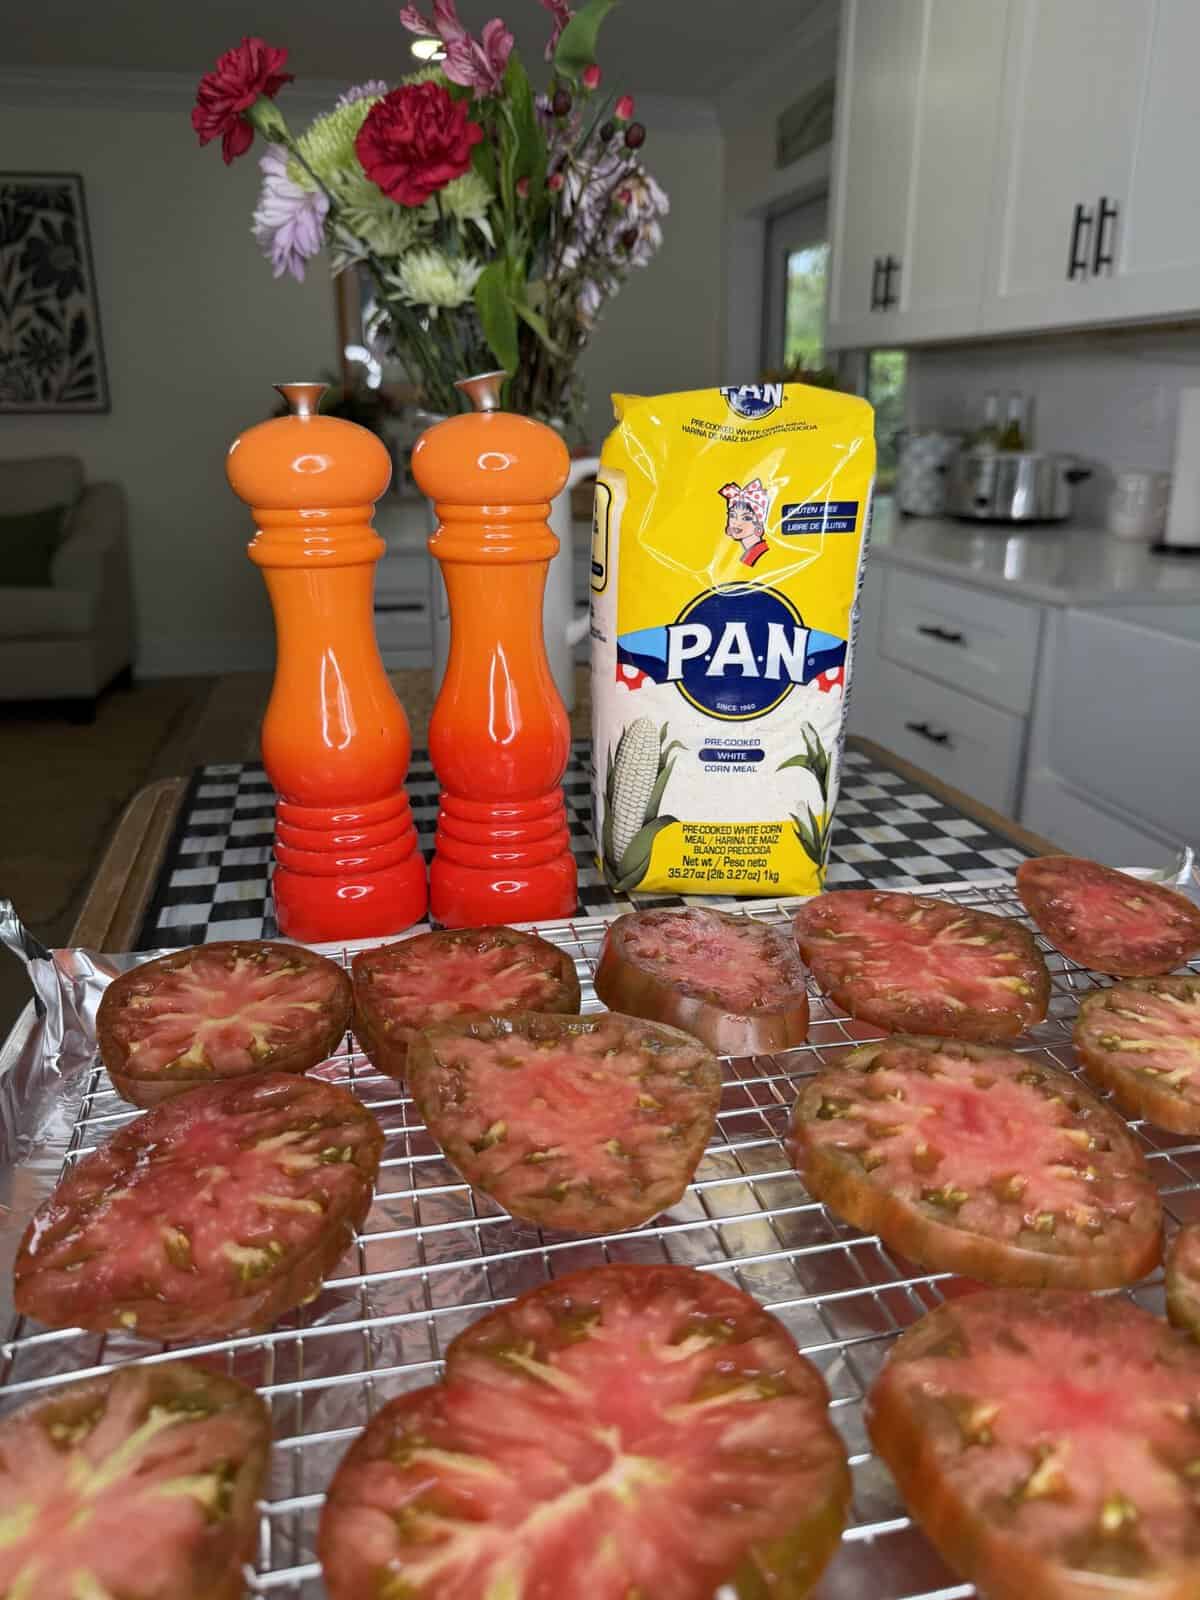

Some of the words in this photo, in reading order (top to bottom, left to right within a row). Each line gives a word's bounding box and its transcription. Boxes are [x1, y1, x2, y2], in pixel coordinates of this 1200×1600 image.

[681, 424, 707, 438] HARINA
[787, 521, 808, 531] LIBRE
[810, 521, 820, 530] DE
[716, 702, 737, 712] SINCE
[704, 737, 760, 746] PRE-COOKED
[717, 751, 747, 760] WHITE
[704, 765, 730, 773] CORN
[733, 825, 760, 835] WHITE
[760, 825, 782, 834] CORN
[685, 835, 707, 845] MEAL
[715, 836, 746, 845] HARINA
[747, 836, 758, 845] DE
[693, 845, 726, 855] BLANCO
[727, 846, 772, 855] PRECOCIDA
[682, 855, 699, 867] Net
[723, 856, 745, 867] Peso
[746, 858, 768, 867] neto
[667, 868, 705, 879] 35.27oz
[706, 869, 725, 881] (2lb
[726, 869, 761, 882] 3.27oz)
[763, 870, 780, 883] 1kg
